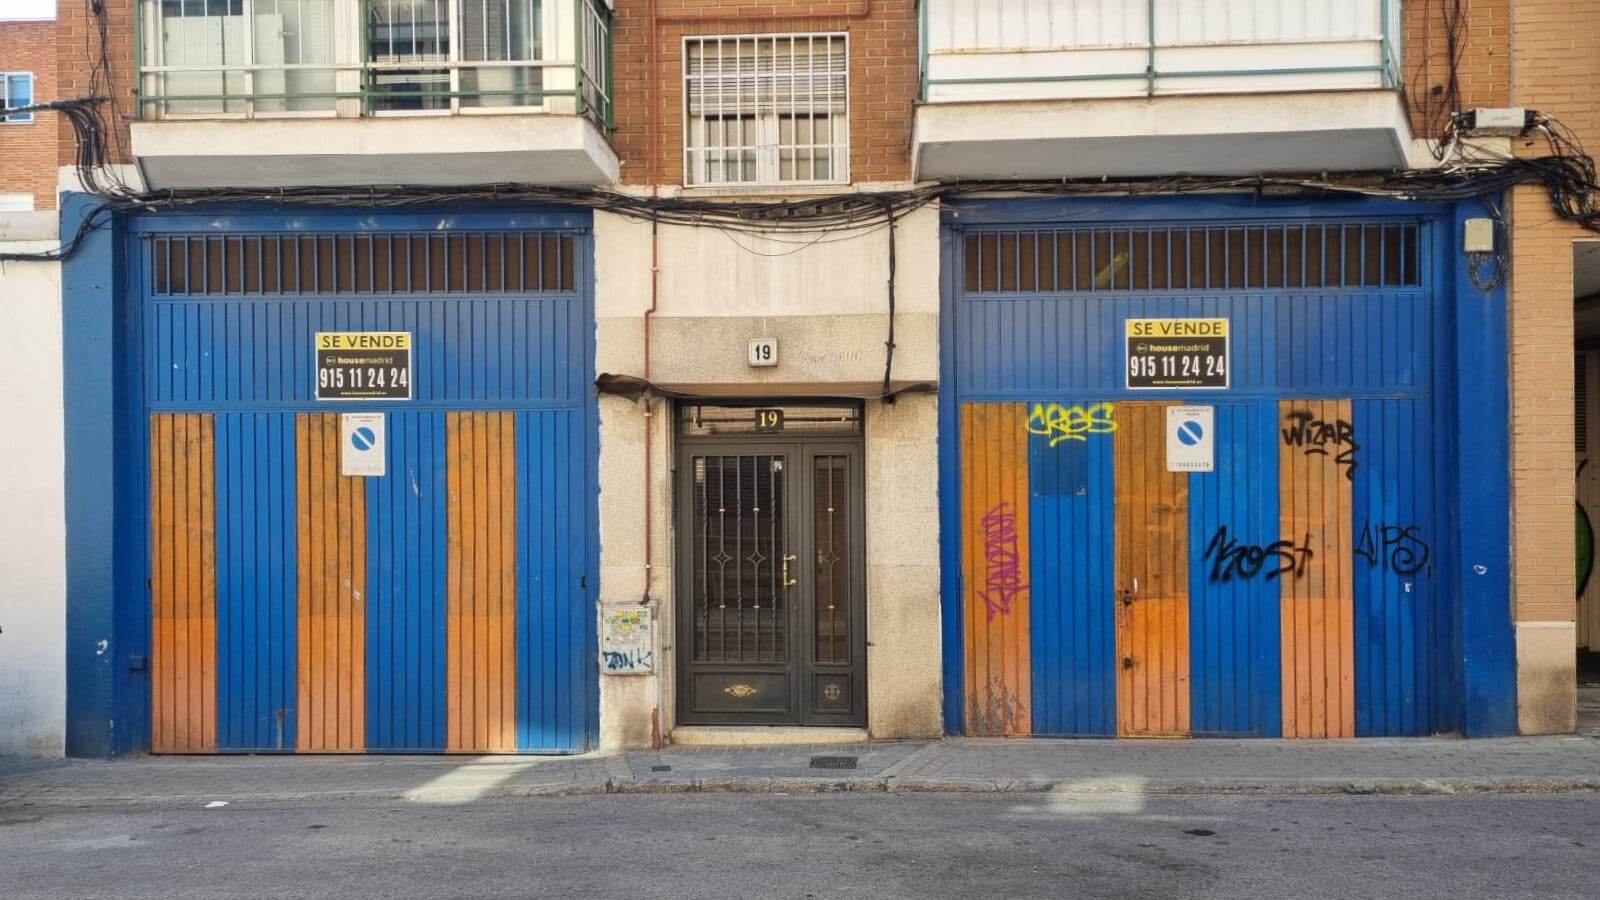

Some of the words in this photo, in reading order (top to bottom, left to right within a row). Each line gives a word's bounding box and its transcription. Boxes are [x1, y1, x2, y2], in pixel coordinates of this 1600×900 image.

[1133, 322, 1153, 335] SE
[1159, 322, 1222, 335] VENDE
[322, 335, 341, 348] SE
[347, 335, 404, 348] VENDE
[1149, 344, 1210, 352] housemadrid
[755, 344, 771, 360] 19
[337, 356, 393, 364] housemadrid
[1130, 355, 1156, 377] 915
[1161, 355, 1175, 377] 11
[1182, 355, 1200, 376] 24
[1206, 355, 1225, 376] 24
[319, 367, 344, 388] 915
[348, 367, 362, 388] 11
[367, 367, 385, 388] 24
[390, 367, 408, 388] 24
[759, 411, 778, 427] 19
